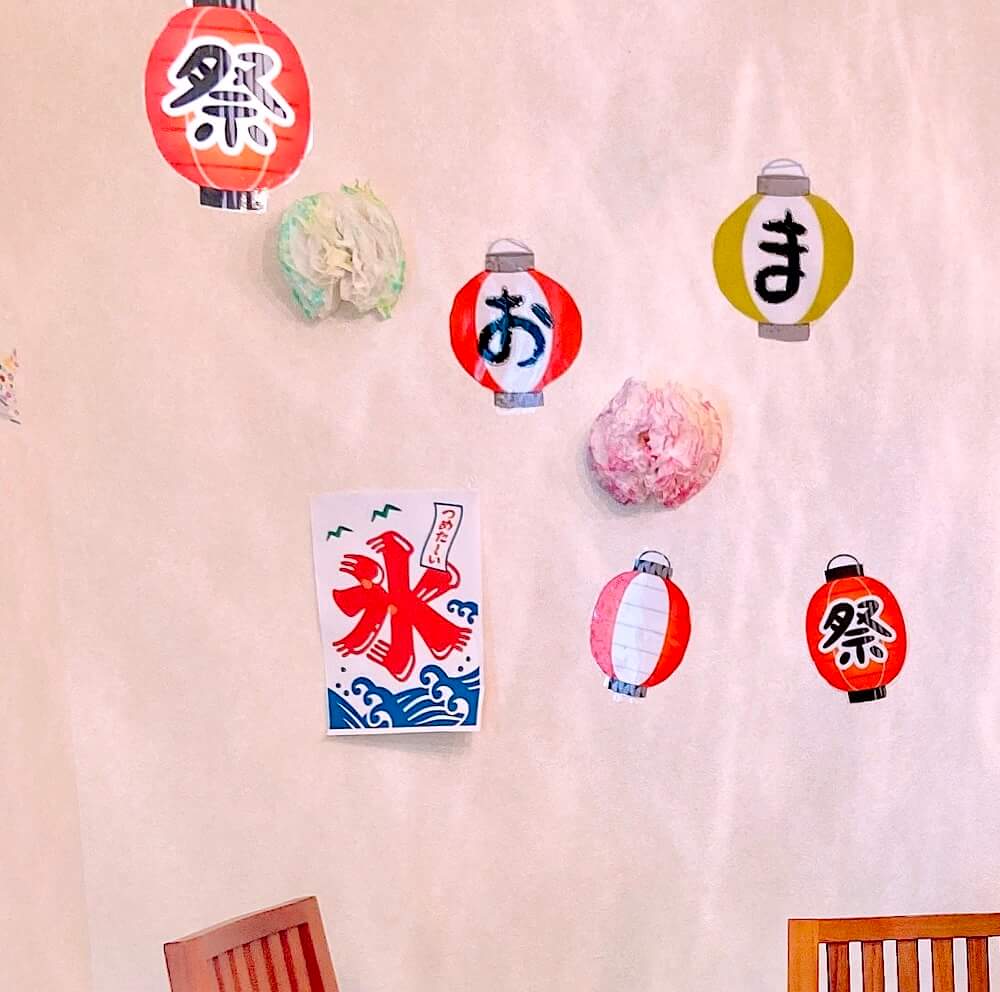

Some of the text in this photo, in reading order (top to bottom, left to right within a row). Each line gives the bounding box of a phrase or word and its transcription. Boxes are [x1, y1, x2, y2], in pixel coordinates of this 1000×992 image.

[166, 41, 293, 151] 祭
[754, 208, 808, 303] ま
[477, 286, 555, 368] お
[332, 531, 472, 681] 氷
[820, 600, 892, 666] 祭
